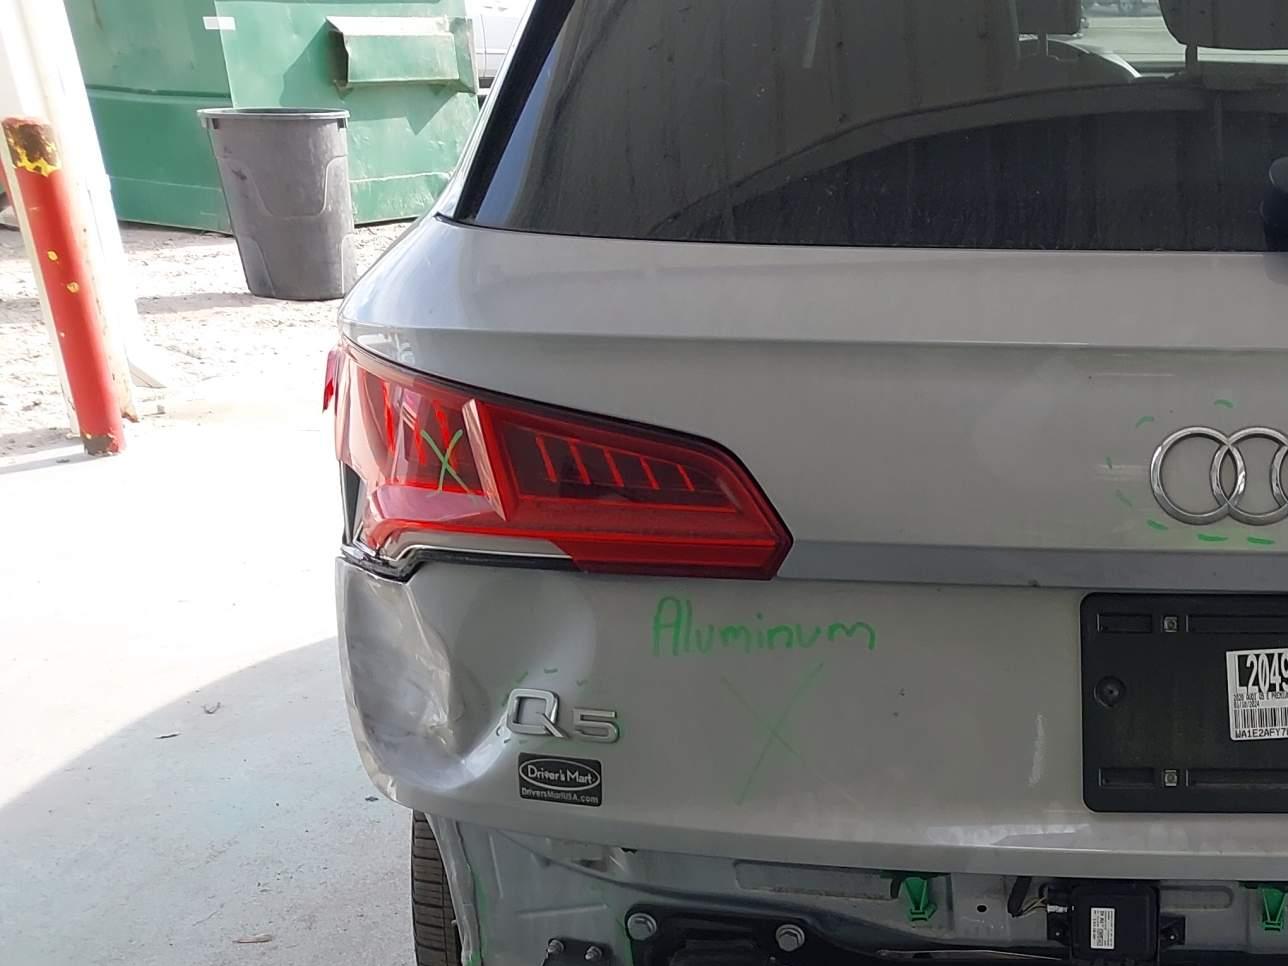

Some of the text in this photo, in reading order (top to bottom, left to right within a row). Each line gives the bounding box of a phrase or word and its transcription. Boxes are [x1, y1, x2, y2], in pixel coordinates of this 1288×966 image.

[652, 595, 876, 656] Aluminum
[506, 688, 620, 744] Q5
[527, 764, 593, 784] Driver's Mart
